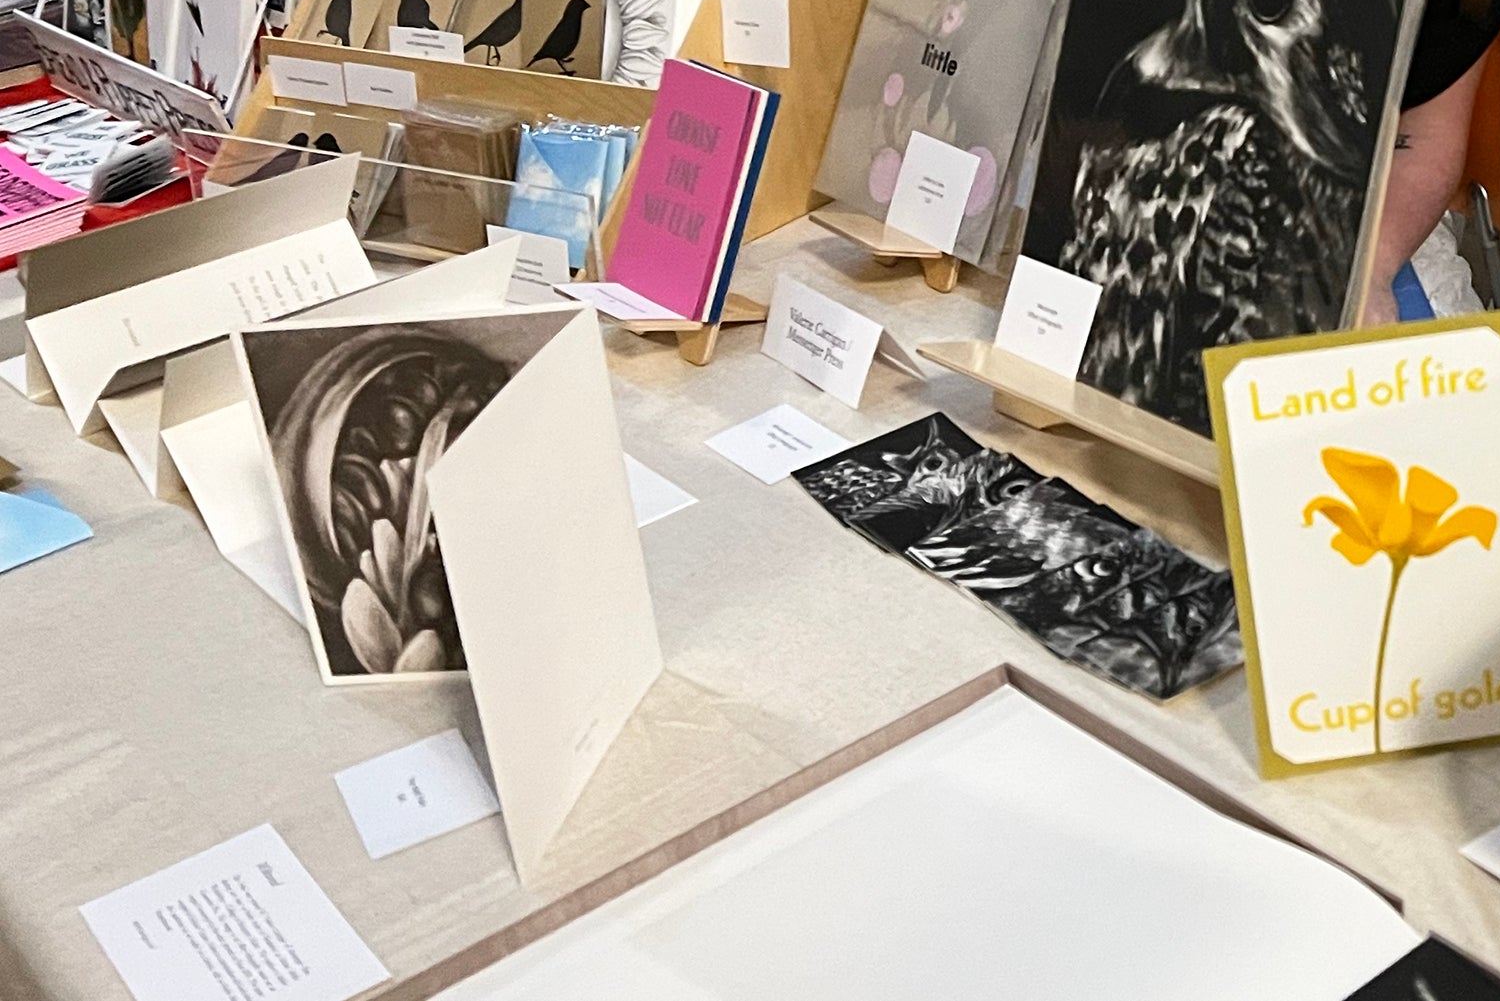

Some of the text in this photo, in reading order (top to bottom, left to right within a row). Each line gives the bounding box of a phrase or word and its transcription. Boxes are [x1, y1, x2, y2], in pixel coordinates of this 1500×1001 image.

[921, 43, 958, 76] little
[1249, 356, 1487, 422] Land of fire
[1288, 691, 1376, 733] Cup
[1384, 677, 1422, 721] of
